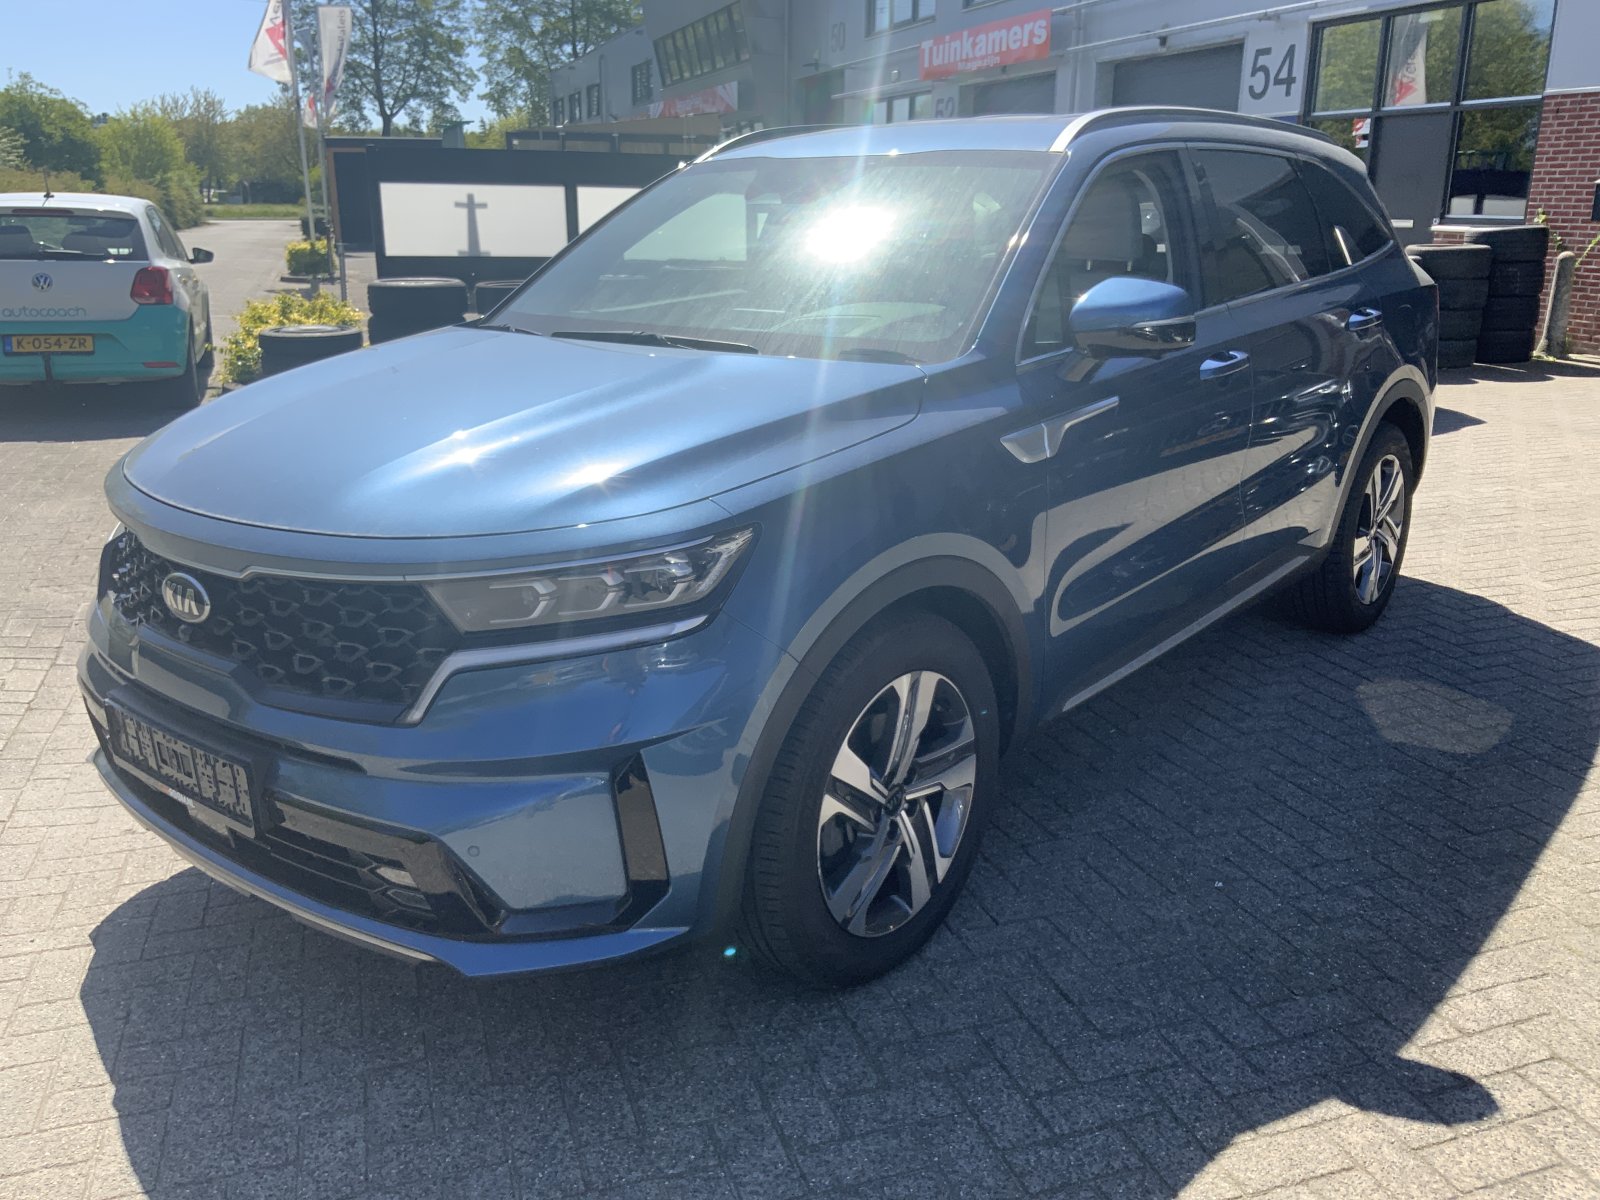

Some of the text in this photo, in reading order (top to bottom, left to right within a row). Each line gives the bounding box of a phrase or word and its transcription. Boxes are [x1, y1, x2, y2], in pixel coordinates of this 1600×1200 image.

[831, 22, 846, 53] 50
[921, 19, 1047, 67] Tuinkamers
[1248, 43, 1297, 100] 54
[2, 305, 87, 318] autocoach
[16, 337, 87, 349] K-054-ZR
[166, 581, 200, 616] KIA
